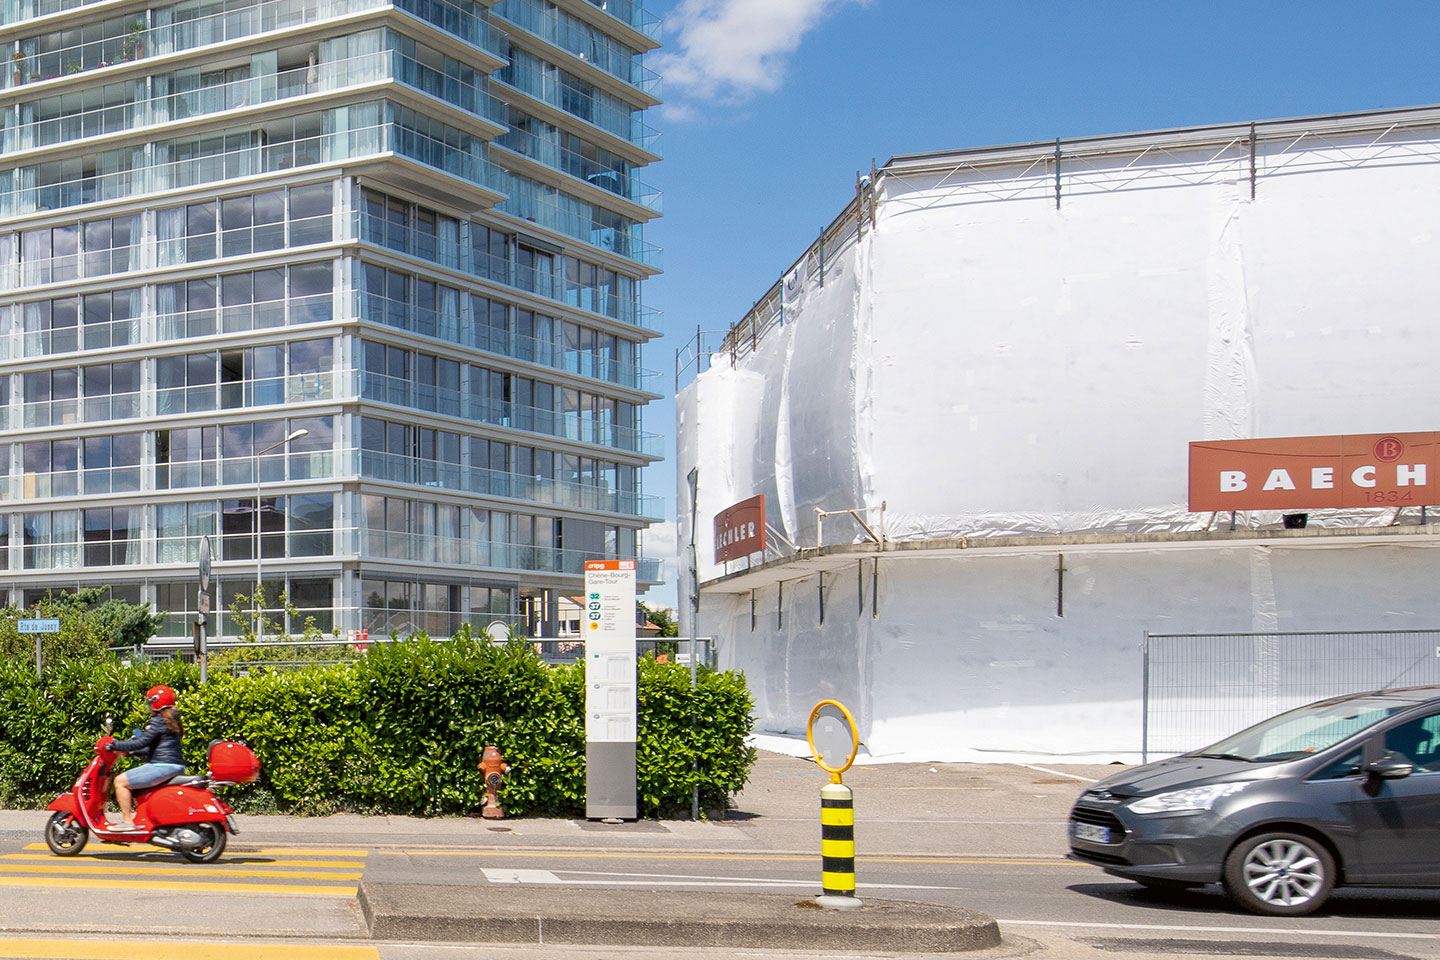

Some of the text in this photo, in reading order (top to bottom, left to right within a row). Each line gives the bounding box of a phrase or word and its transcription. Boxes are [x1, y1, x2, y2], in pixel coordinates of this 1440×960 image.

[1382, 441, 1398, 458] B
[1220, 463, 1427, 493] BAECH
[1365, 490, 1413, 503] 1834
